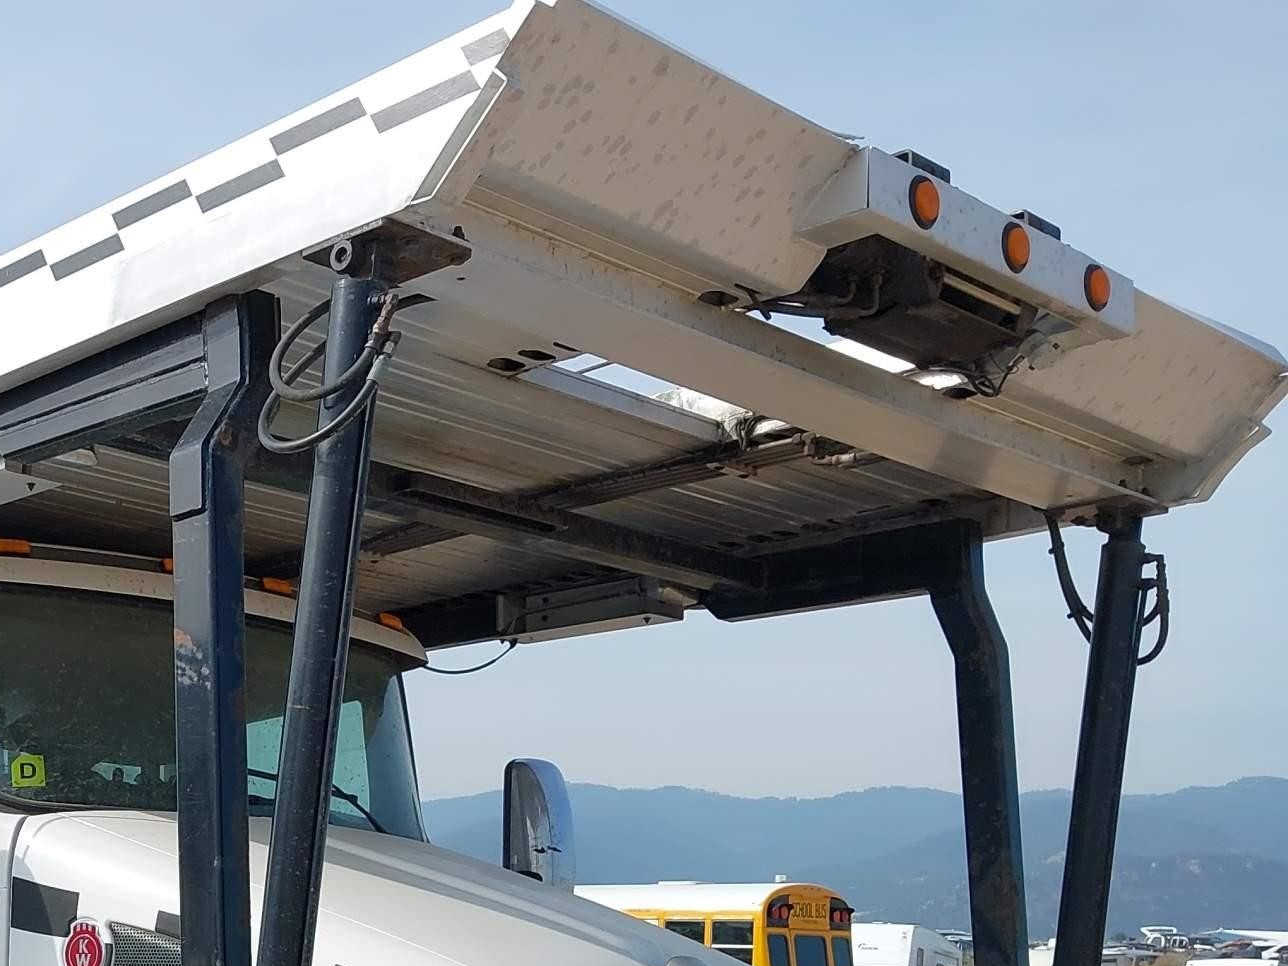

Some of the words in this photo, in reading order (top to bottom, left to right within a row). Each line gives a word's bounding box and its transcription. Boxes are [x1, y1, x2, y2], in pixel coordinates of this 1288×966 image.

[20, 763, 37, 779] D
[792, 902, 814, 918] SCHOOL
[815, 903, 827, 919] BUS
